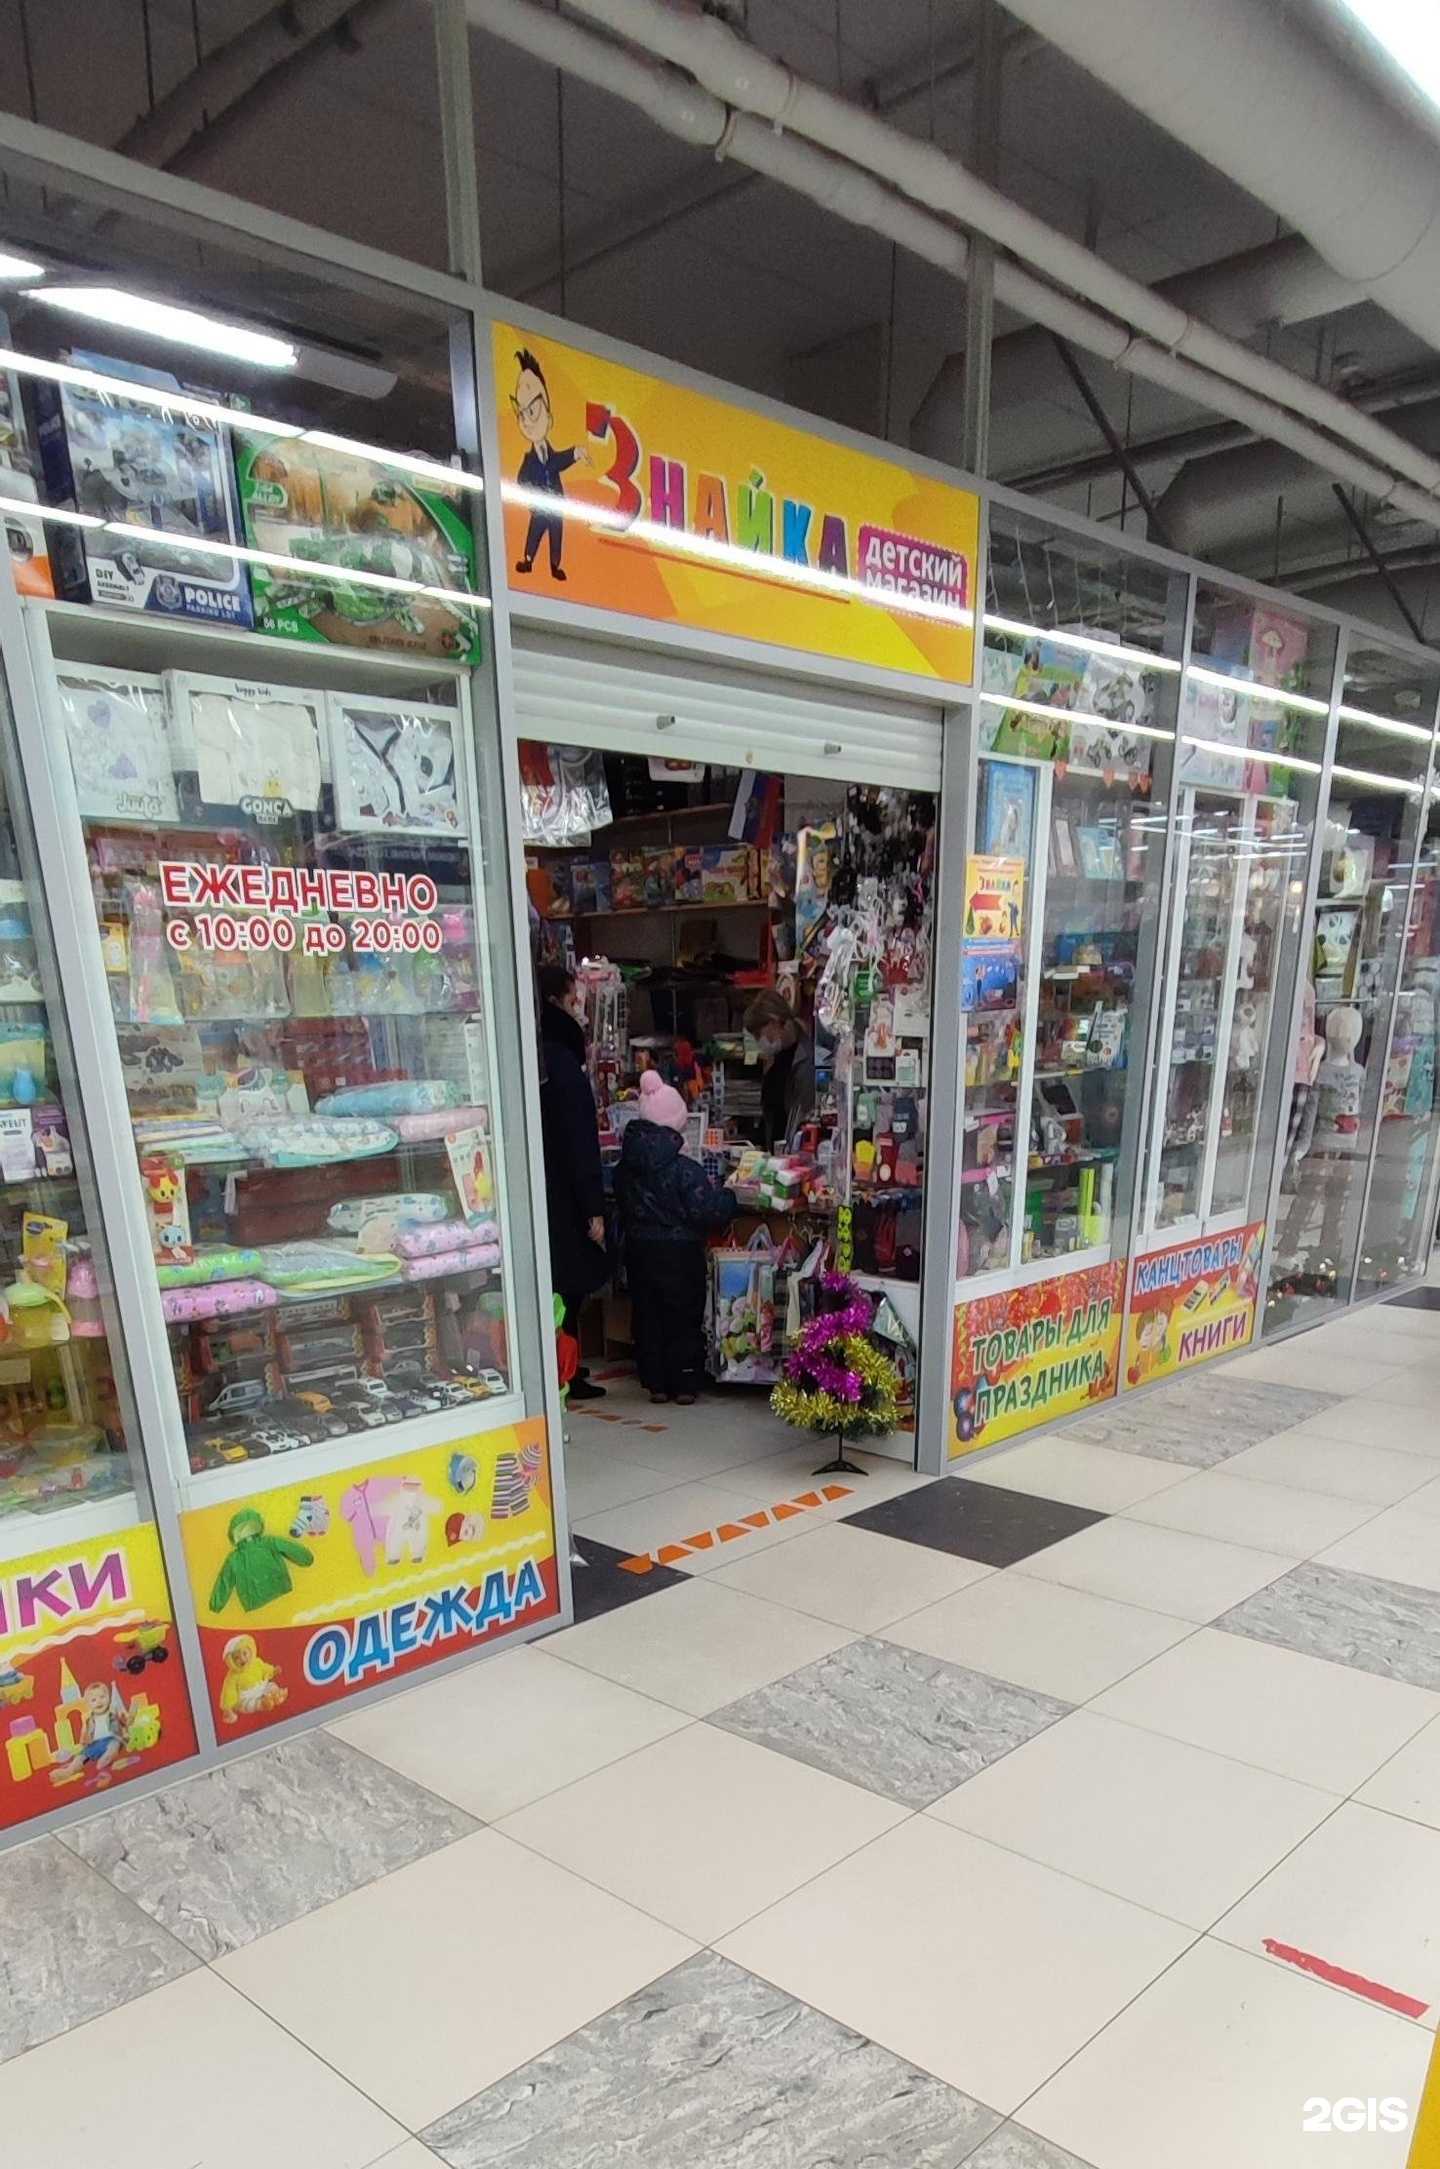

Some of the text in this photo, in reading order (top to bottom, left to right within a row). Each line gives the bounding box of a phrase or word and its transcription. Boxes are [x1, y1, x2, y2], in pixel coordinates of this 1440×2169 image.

[585, 400, 850, 578] ЗНАЙКА
[864, 568, 962, 609] магазин
[865, 536, 963, 590] детский
[184, 585, 241, 612] POLICE
[278, 618, 299, 633] PCS
[161, 863, 438, 914] ЕЖЕДНЕВНО
[198, 915, 294, 951] 10:00
[306, 925, 346, 953] до
[355, 920, 441, 952] 20:00
[1136, 1235, 1244, 1293] КАНЦТОВАРЫ
[972, 1298, 1112, 1374] ТОВАРЫ ДЛЯ
[1179, 1312, 1247, 1362] КНИГИ
[974, 1350, 1105, 1425] ПРАЗДНИКА
[0, 1551, 127, 1636] КИ
[307, 1559, 544, 1683] ОДЕЖДА
